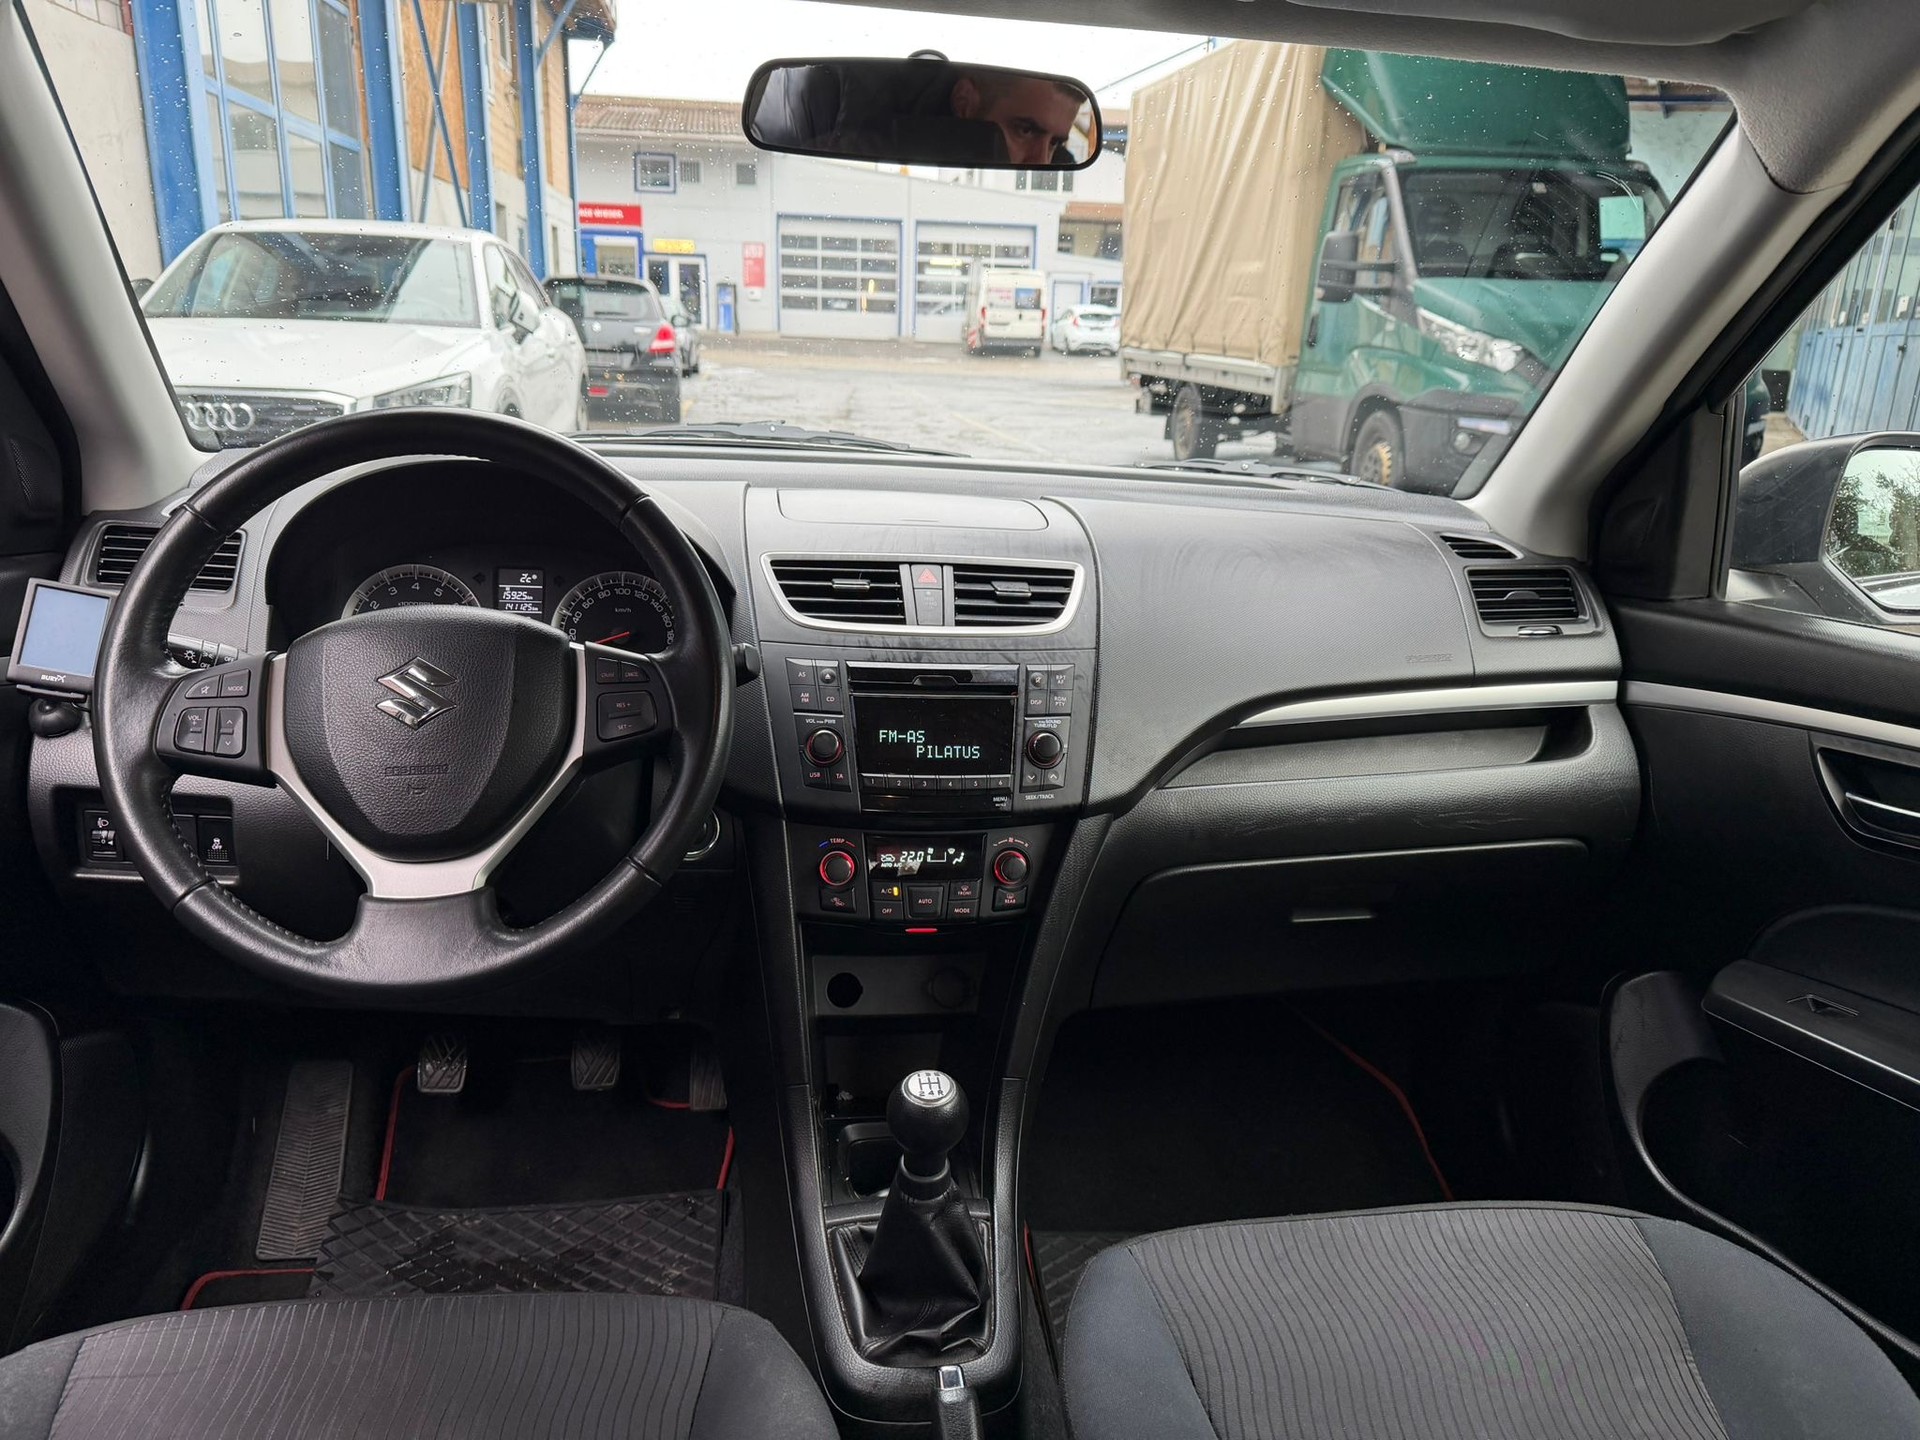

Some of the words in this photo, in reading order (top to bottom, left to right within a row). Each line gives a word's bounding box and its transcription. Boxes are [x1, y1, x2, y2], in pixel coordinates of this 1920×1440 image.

[388, 586, 398, 596] 3
[411, 582, 420, 590] 4
[433, 587, 444, 597] 5
[614, 587, 631, 596] 100
[597, 589, 611, 600] 80
[634, 589, 650, 601] 120
[369, 600, 380, 610] 2
[582, 598, 595, 609] 60
[650, 598, 664, 613] 140
[572, 611, 583, 624] 40
[661, 612, 673, 628] 160
[568, 628, 577, 641] 20
[879, 729, 926, 744] FM-AS
[916, 745, 981, 759] PILATUS
[900, 850, 924, 863] 22.0
